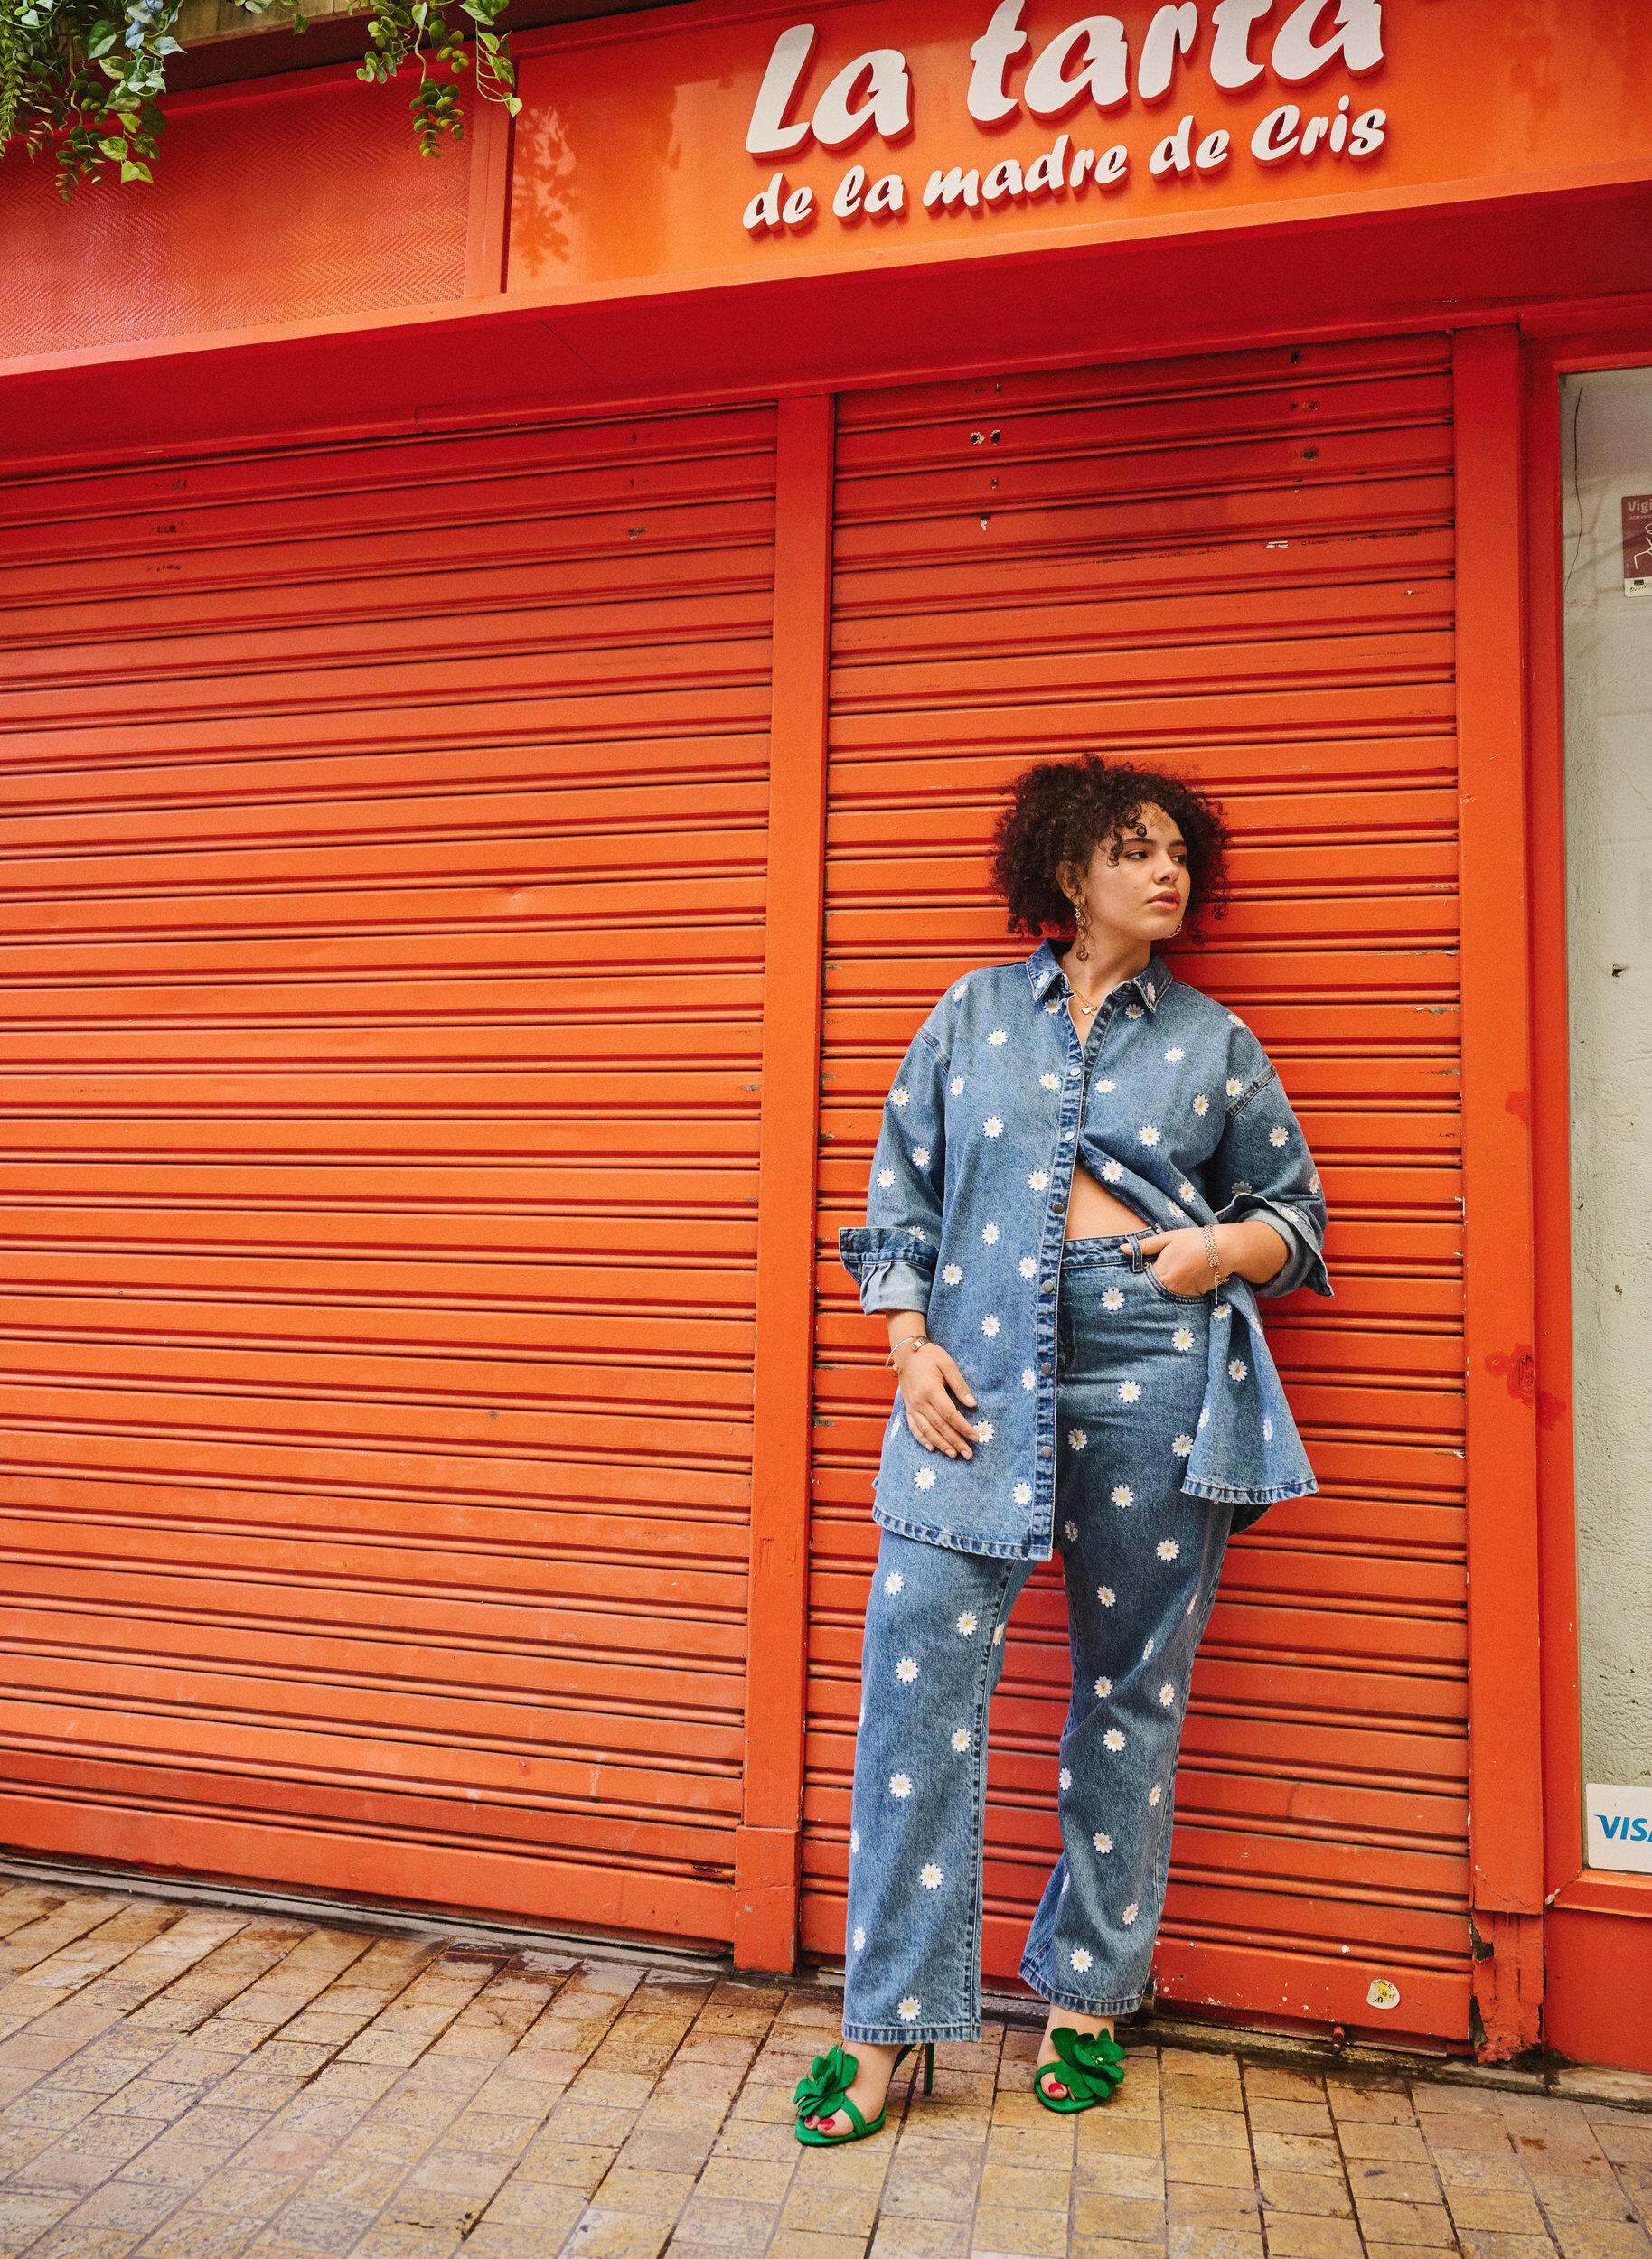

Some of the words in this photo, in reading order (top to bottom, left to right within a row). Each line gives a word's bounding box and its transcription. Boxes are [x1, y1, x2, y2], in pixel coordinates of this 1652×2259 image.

[746, 23, 910, 154] La
[967, 0, 1384, 121] tarta
[742, 173, 812, 230] de
[832, 164, 904, 218] la
[922, 134, 1128, 207] madre
[1149, 115, 1230, 174] de
[1251, 95, 1387, 161] Cris
[1593, 1814, 1652, 1842] VIS
